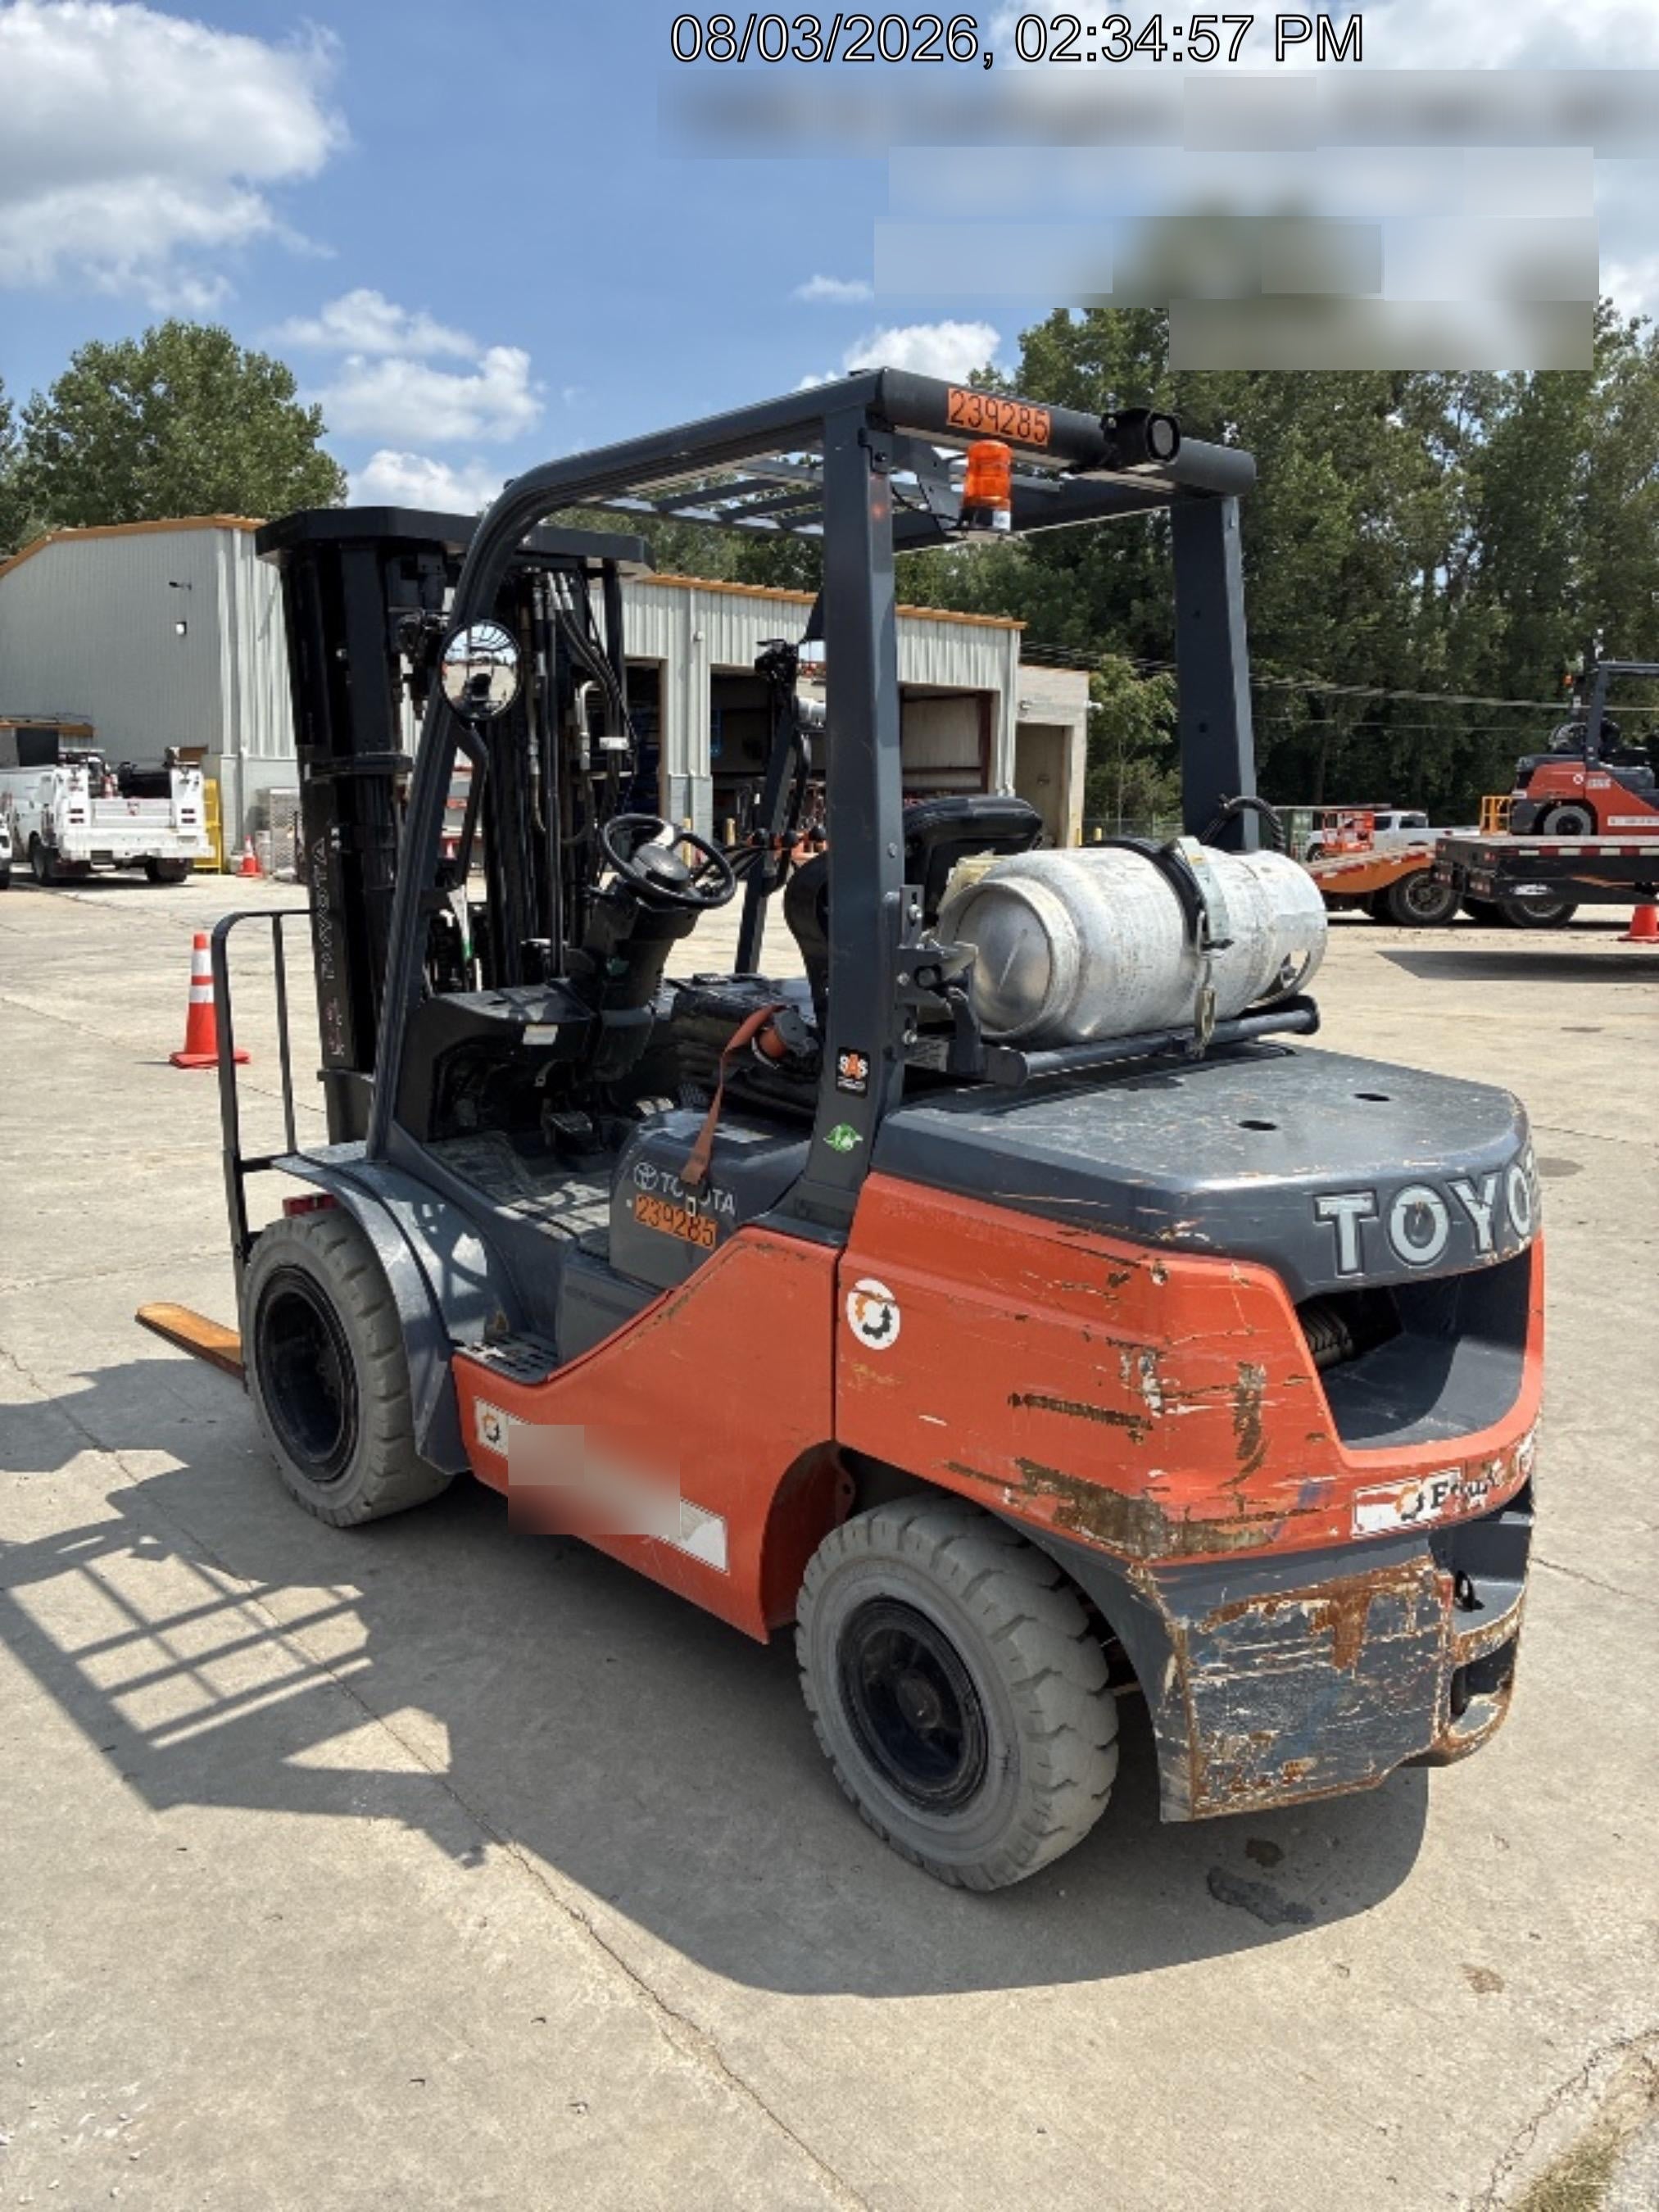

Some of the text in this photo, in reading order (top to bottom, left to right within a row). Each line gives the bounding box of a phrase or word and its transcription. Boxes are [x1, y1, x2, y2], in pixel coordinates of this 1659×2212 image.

[950, 389, 1049, 443] 239285
[660, 1172, 736, 1216] TOTA
[1313, 1149, 1533, 1274] TOYO
[637, 1195, 714, 1247] 239285
